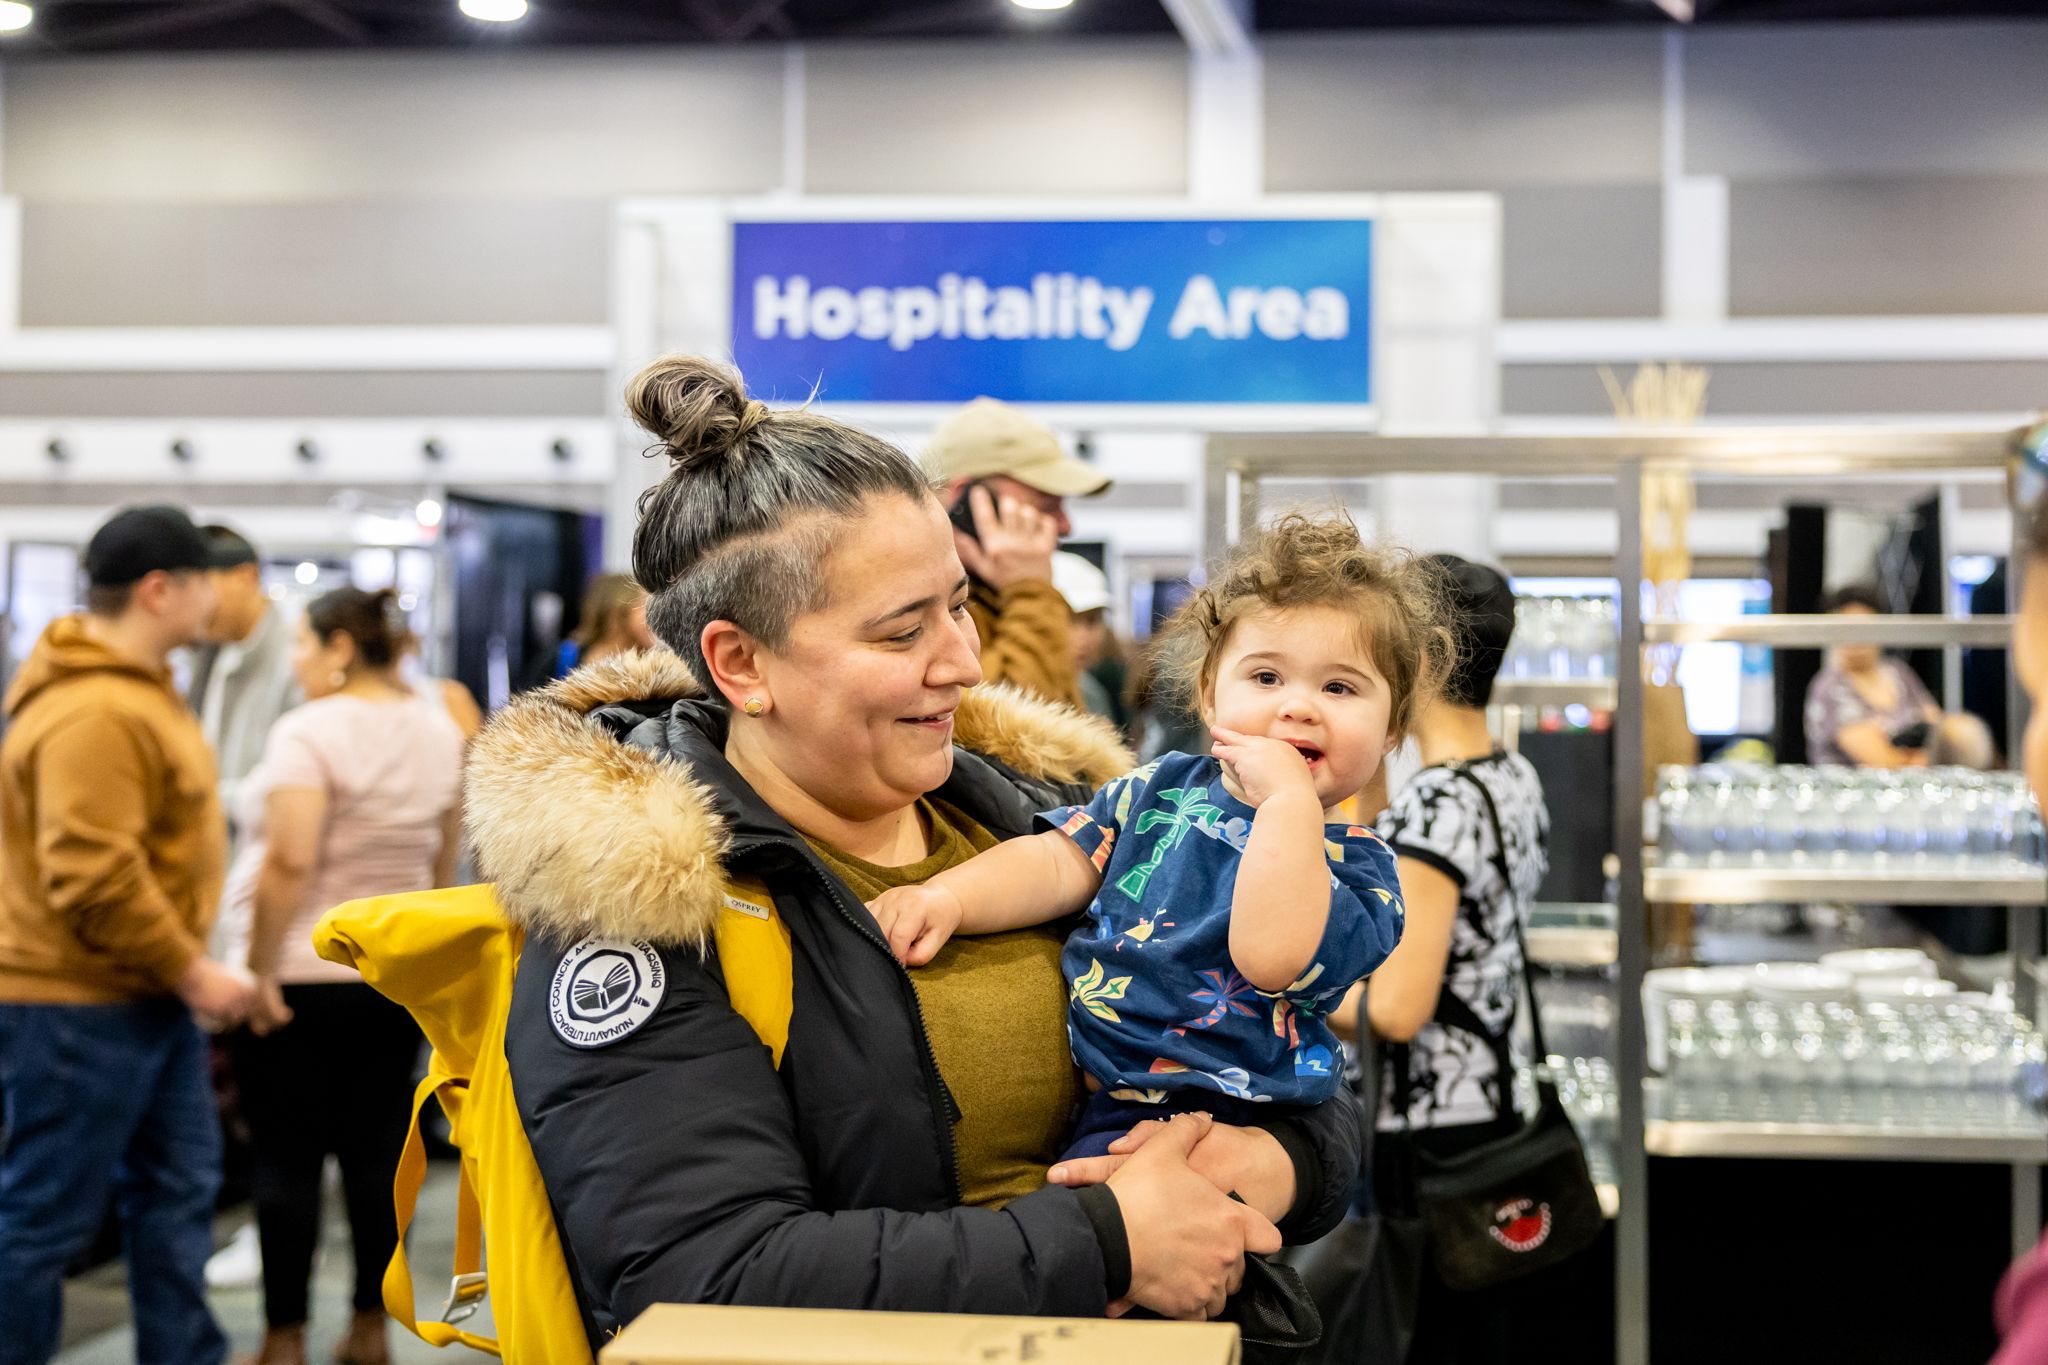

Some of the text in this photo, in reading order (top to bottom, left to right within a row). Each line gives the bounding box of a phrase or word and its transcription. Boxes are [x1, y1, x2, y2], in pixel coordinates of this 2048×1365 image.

[753, 272, 1350, 352] Hospitality Area
[731, 900, 761, 913] OSPREY
[552, 958, 635, 1042] NUNAVUT LITERACY COUNCIL
